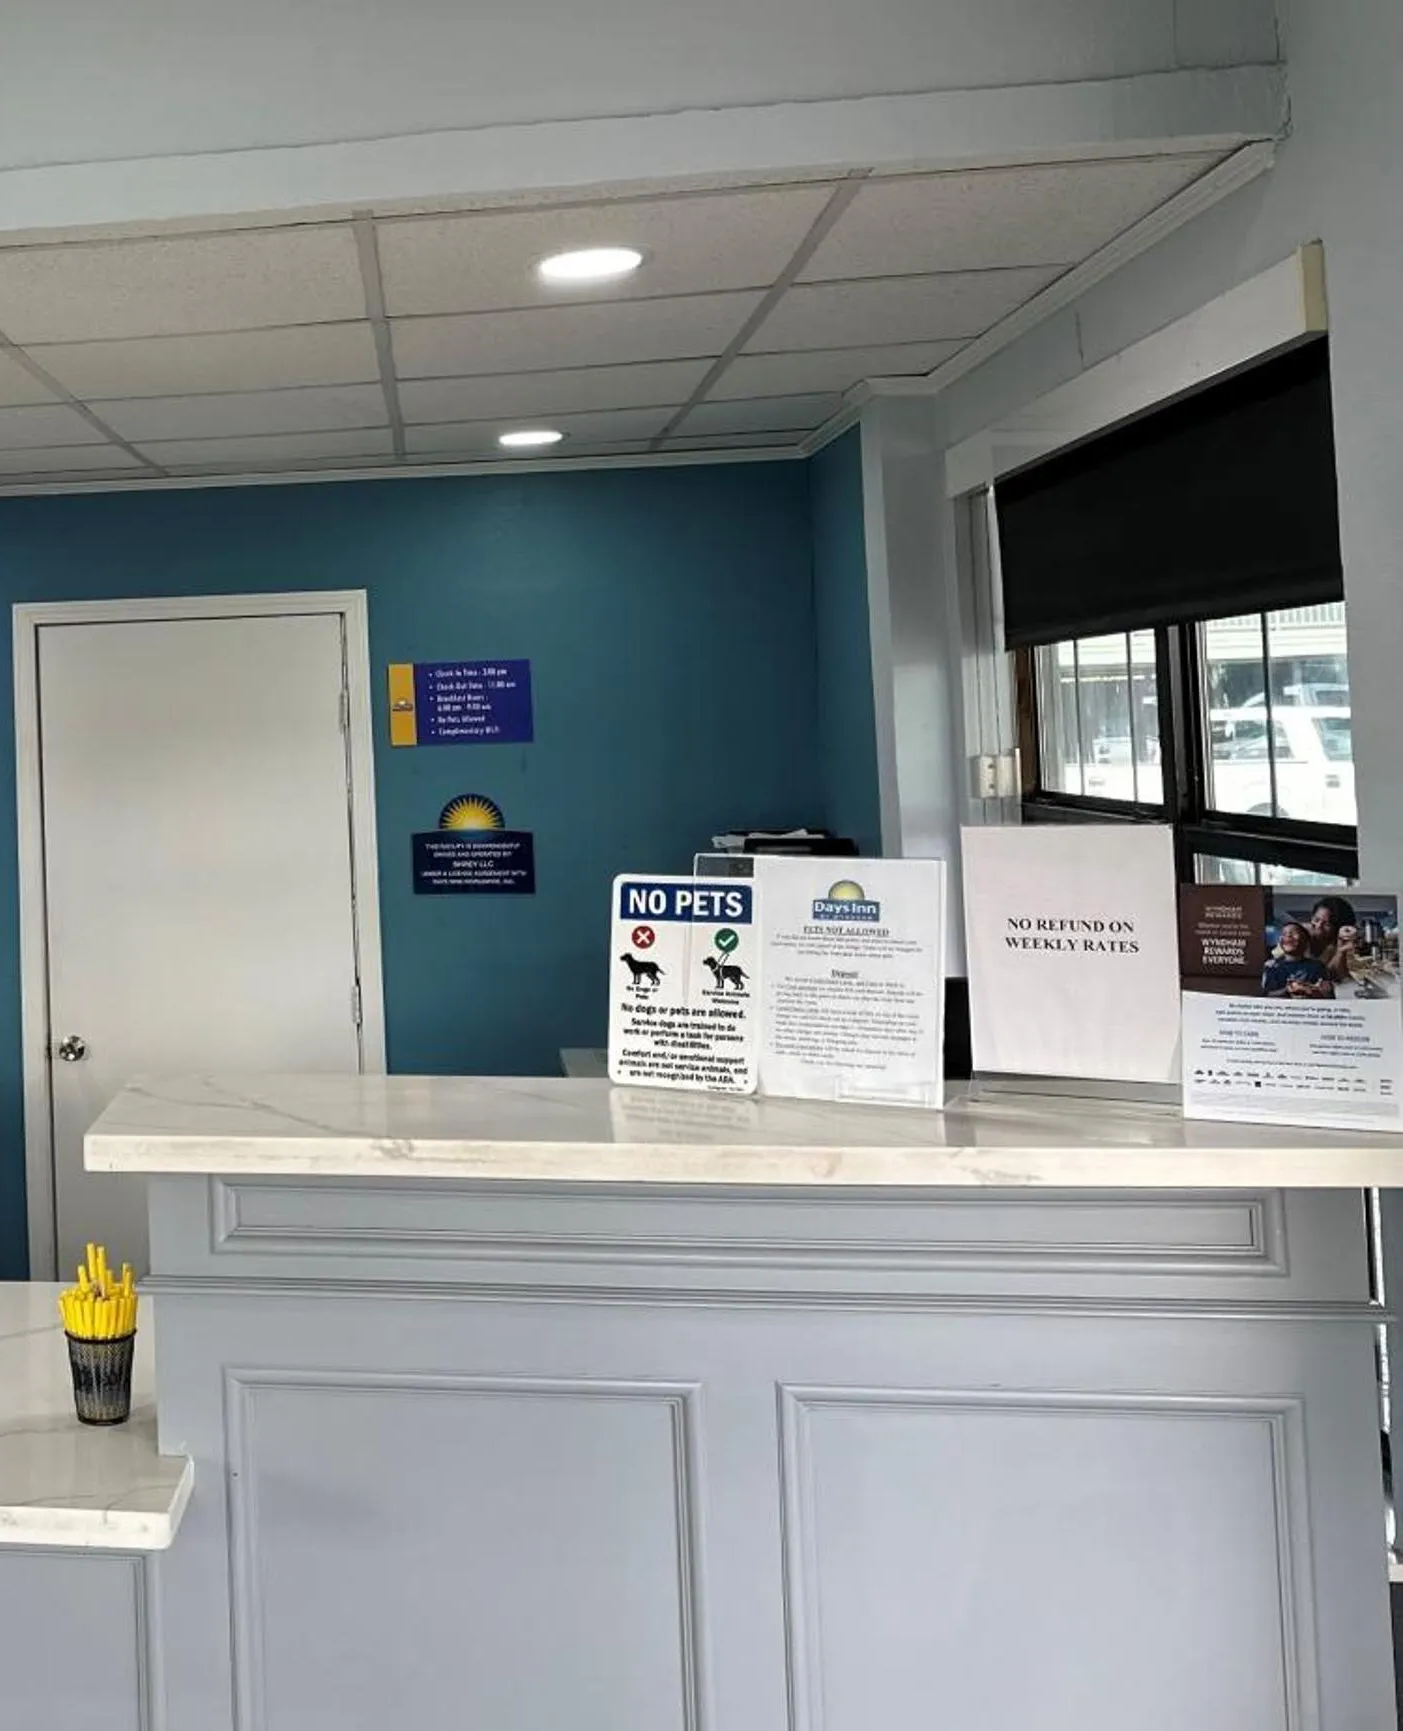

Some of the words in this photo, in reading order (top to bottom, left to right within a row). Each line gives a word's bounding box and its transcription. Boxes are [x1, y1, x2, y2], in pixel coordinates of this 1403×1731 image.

[629, 888, 666, 915] NO
[676, 890, 743, 917] PETS
[814, 901, 849, 914] Days
[852, 903, 876, 914] Inn
[826, 926, 843, 936] NOT
[846, 927, 890, 938] ALLOWED
[1007, 917, 1032, 930] NO
[1037, 919, 1105, 933] REFUND
[1108, 920, 1134, 933] ON
[1005, 937, 1078, 951] WEEKLY
[1083, 939, 1140, 953] RATES
[1201, 938, 1246, 947] WYNDHAM
[621, 1002, 634, 1013] No
[635, 1004, 656, 1016] dogs
[658, 1006, 668, 1014] or
[669, 1006, 690, 1017] pets
[691, 1008, 706, 1017] are
[708, 1008, 747, 1019] allowed.
[631, 1018, 657, 1027] Service
[659, 1019, 676, 1029] dogs
[690, 1021, 716, 1030] trained
[718, 1023, 725, 1031] to
[726, 1024, 736, 1032] do
[650, 1029, 679, 1038] perform
[686, 1031, 702, 1039] task
[703, 1031, 713, 1040] for
[715, 1033, 744, 1042] persons
[622, 1048, 651, 1058] Comfort
[679, 1053, 715, 1062] emotional
[716, 1056, 745, 1065] support
[618, 1059, 647, 1067] animals
[674, 1063, 700, 1071] service
[734, 1067, 748, 1075] and
[629, 1069, 641, 1077] are
[656, 1071, 694, 1081] recognized
[695, 1073, 704, 1082] by
[705, 1074, 717, 1082] the
